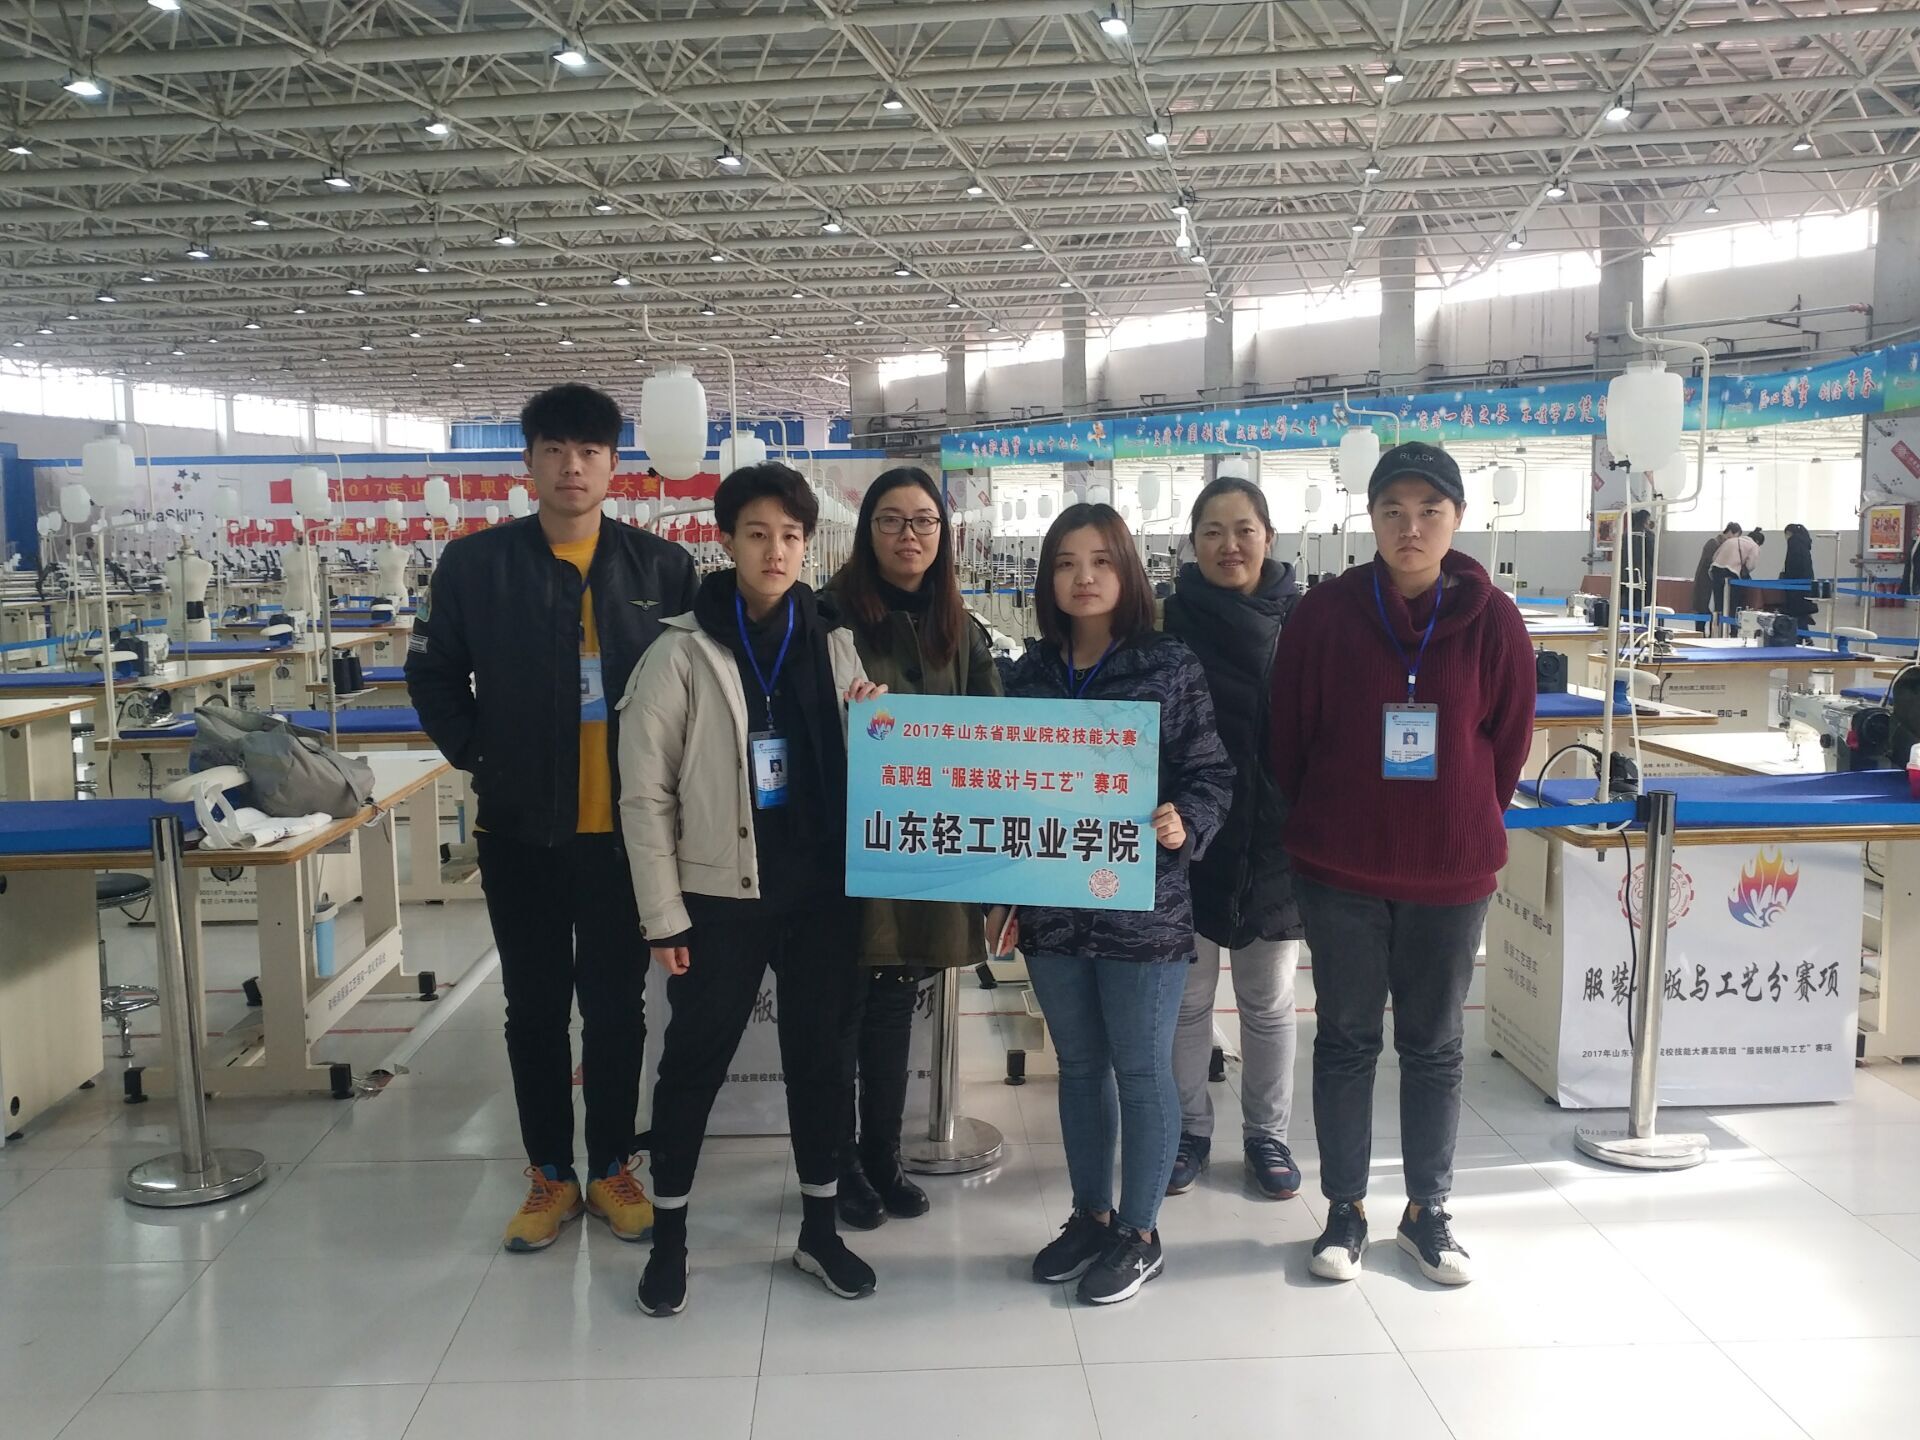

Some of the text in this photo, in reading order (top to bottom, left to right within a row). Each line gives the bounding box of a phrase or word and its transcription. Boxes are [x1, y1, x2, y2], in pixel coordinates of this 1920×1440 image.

[1400, 452, 1435, 462] BLACK
[903, 722, 1137, 747] 2017年山东省职业院校技能大赛
[864, 810, 1140, 863] 山东轻工职业学院
[1583, 959, 1840, 1006] 服装版与工艺分赛项
